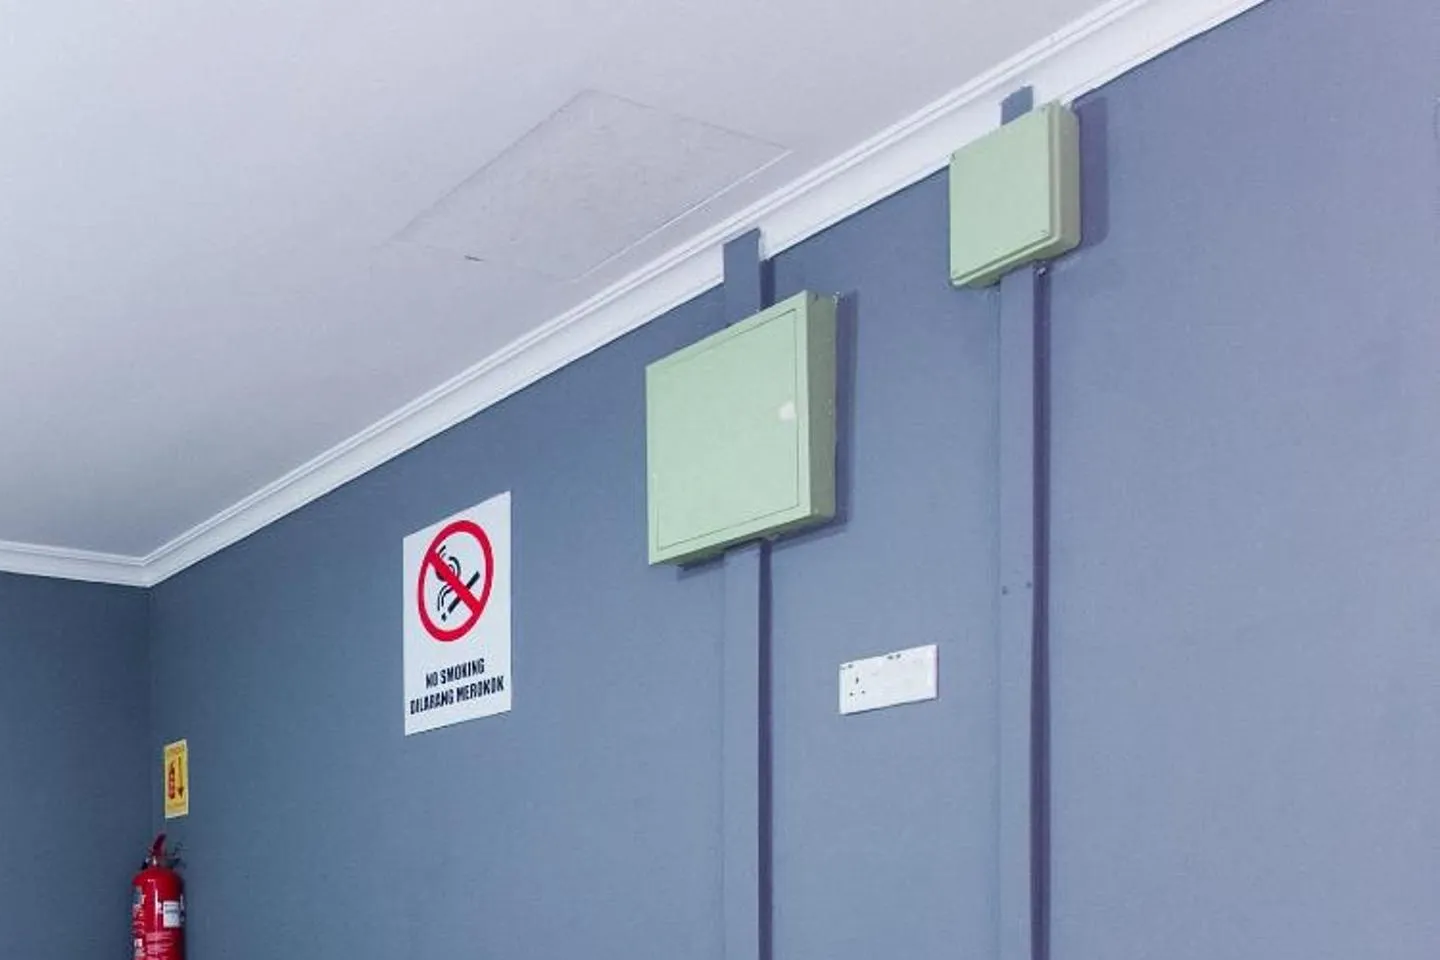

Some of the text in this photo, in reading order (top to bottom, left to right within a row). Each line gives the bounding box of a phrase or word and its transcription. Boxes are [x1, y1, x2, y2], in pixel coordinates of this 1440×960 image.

[426, 658, 485, 689] NO SMOKING
[410, 675, 504, 715] DILARANG MEROKOK
